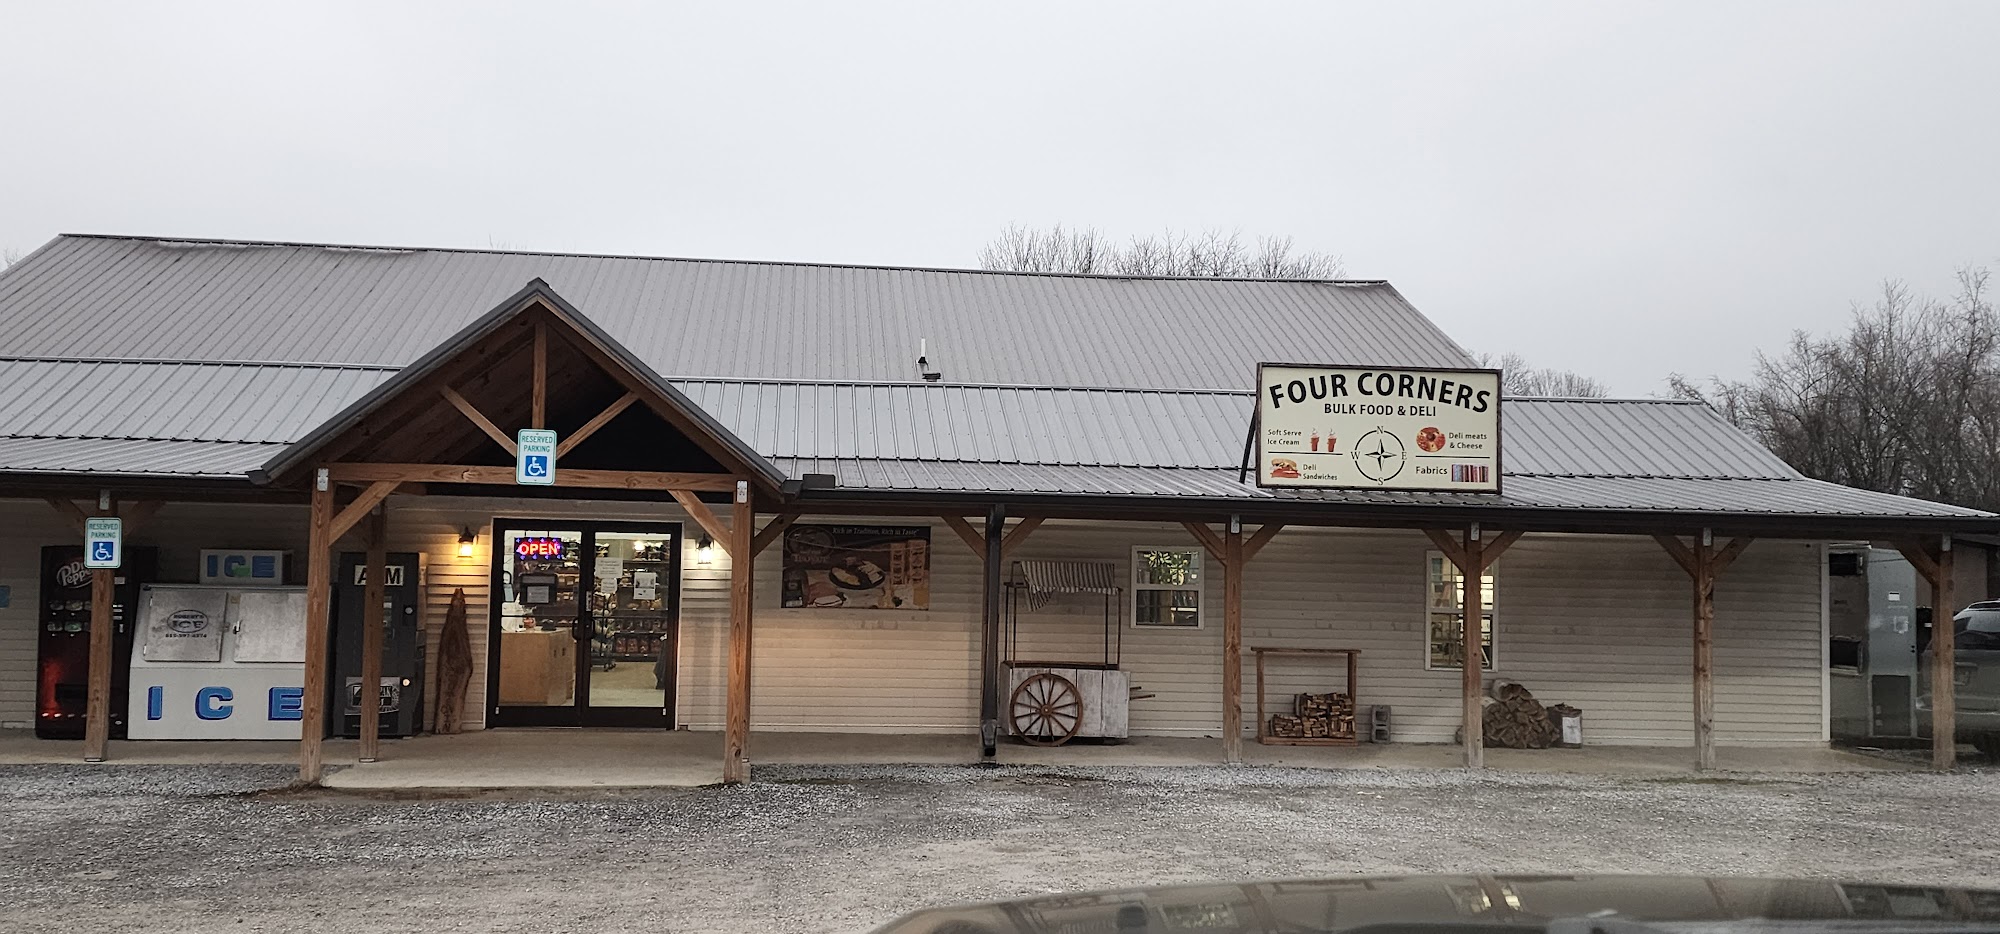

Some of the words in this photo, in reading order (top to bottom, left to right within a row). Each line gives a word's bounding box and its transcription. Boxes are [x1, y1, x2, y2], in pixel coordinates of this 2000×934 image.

[1269, 373, 1348, 409] FOUR
[1357, 372, 1491, 414] CORNERS
[1324, 403, 1356, 415] BULK
[1359, 404, 1394, 416] FOOD
[1397, 405, 1407, 416] &
[1410, 406, 1437, 417] DELI
[1267, 428, 1282, 436] Soft
[1376, 425, 1384, 435] N
[521, 435, 553, 444] RESERVED
[1448, 432, 1464, 440] Deli
[1278, 438, 1300, 446] Cream
[1456, 442, 1483, 450] Cheese
[523, 444, 551, 453] PARKING
[1350, 451, 1361, 460] W
[1401, 452, 1408, 460] E
[1302, 463, 1317, 471] Deli
[1415, 465, 1448, 475] Fabrics
[1302, 472, 1338, 480] Sandwiches
[1377, 476, 1384, 486] S
[88, 523, 119, 531] RESERVED
[91, 531, 117, 539] PARKING
[519, 542, 559, 555] OPEN
[206, 554, 276, 578] ICE
[57, 565, 93, 586] Peppe
[357, 567, 400, 585] AM
[172, 620, 204, 629] ICE
[147, 685, 304, 721] ICE
